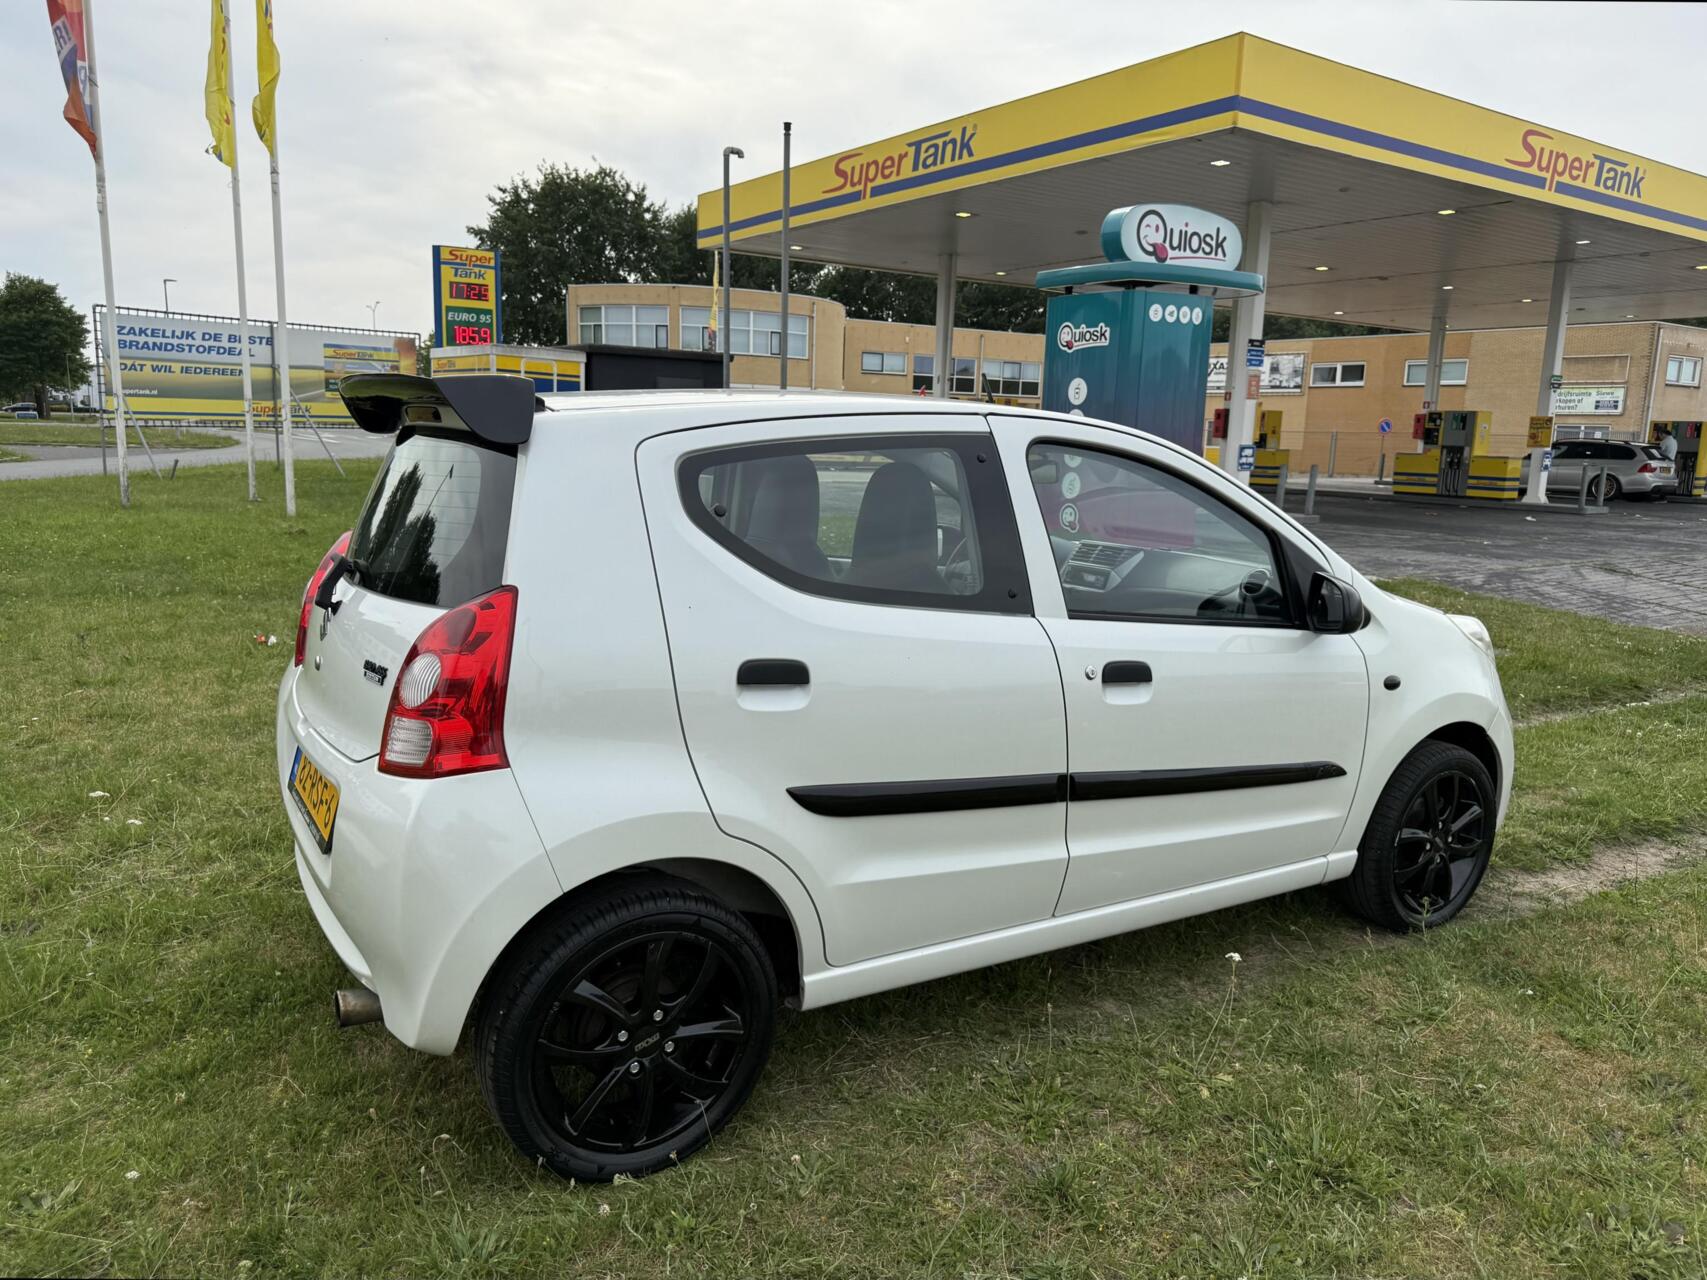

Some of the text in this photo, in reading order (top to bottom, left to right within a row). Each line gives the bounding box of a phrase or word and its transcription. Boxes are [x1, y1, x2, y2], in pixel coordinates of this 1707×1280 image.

[822, 126, 977, 200] SuperTank
[1504, 129, 1646, 198] SuperTank
[1136, 209, 1228, 263] Quiosk
[442, 249, 494, 267] Super
[449, 267, 487, 280] Tank
[447, 311, 492, 324] EURO 95
[117, 325, 196, 341] ZAKELIJK
[201, 331, 222, 343] DE
[1059, 323, 1109, 351] Quiosk
[151, 364, 176, 374] WIL
